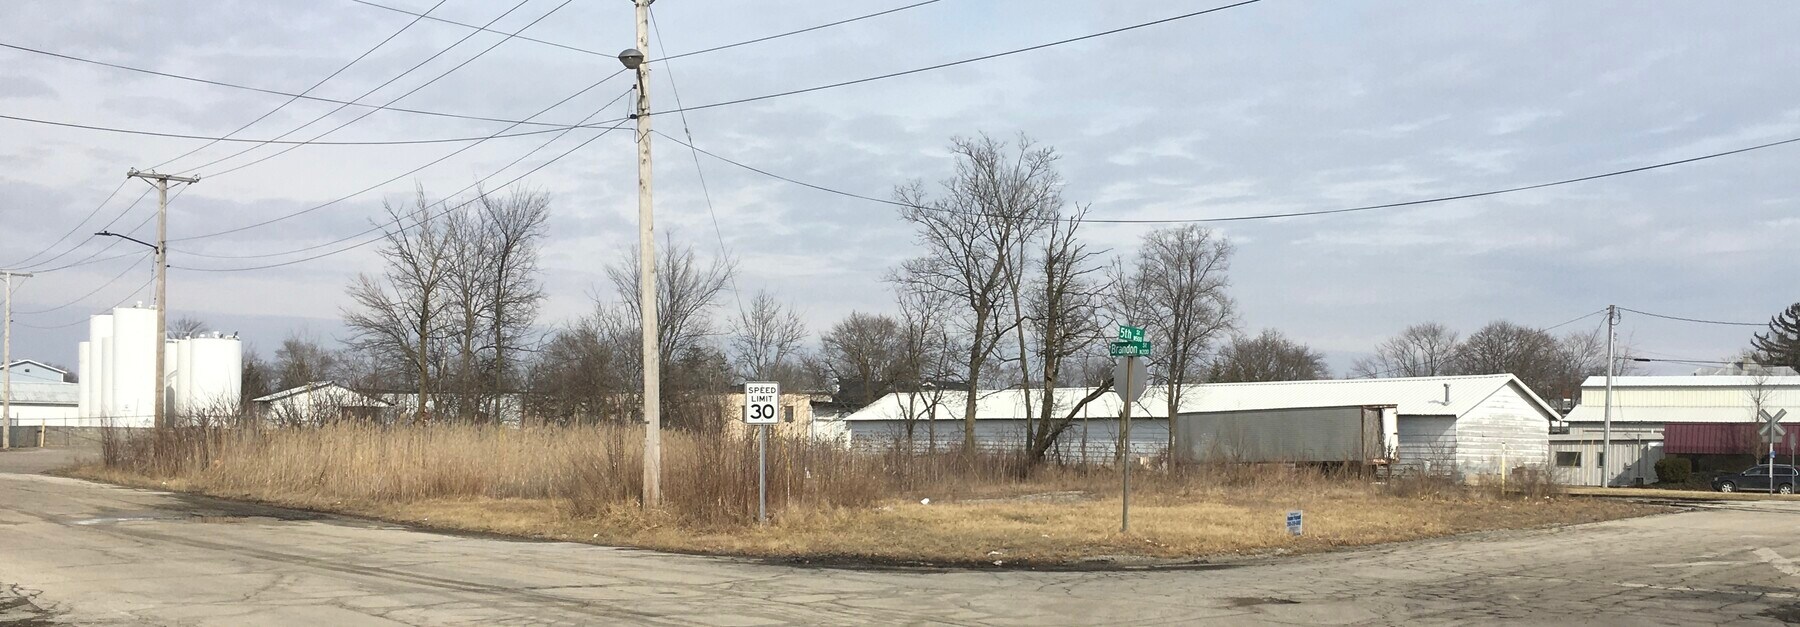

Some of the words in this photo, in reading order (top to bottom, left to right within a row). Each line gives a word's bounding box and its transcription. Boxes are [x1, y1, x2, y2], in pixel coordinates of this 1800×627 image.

[1120, 327, 1132, 339] 5th
[1111, 343, 1138, 354] Brandon
[750, 404, 775, 419] 30
